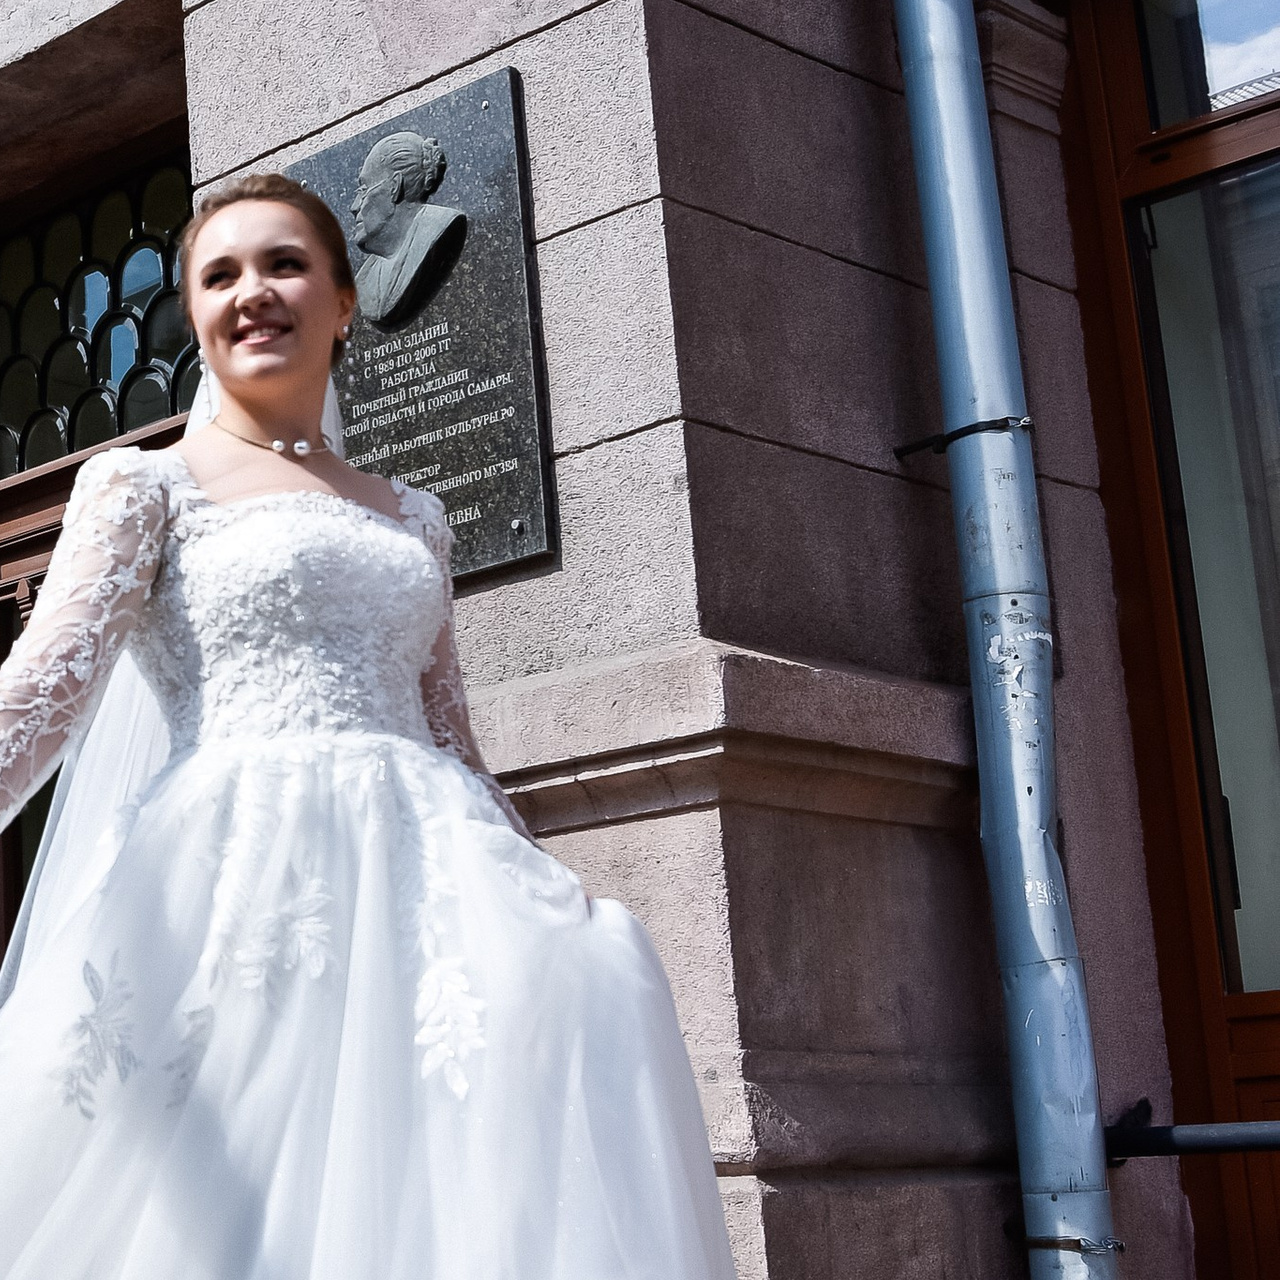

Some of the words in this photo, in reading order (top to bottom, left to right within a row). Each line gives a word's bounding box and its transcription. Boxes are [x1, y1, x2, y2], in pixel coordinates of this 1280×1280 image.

[363, 350, 371, 363] В
[372, 339, 402, 360] ЭТОМ
[403, 321, 449, 349] ЗДАНИИ
[364, 366, 372, 380] С
[396, 351, 412, 369] ПО
[413, 343, 437, 362] 2006
[352, 387, 407, 419] ПОЧЕТНЫЙ
[408, 368, 470, 399] ГРАЖДАНИН
[380, 360, 437, 391] РАБОТАЛА
[371, 404, 417, 429] ОБЛАСТИ
[418, 401, 426, 414] И
[427, 388, 466, 411] ГОРОДА
[391, 428, 444, 455] РАБОТНИК
[444, 410, 500, 439] КУЛЬТУРЫ
[500, 405, 516, 421] РФ
[483, 457, 519, 480] МУЗЕЯ
